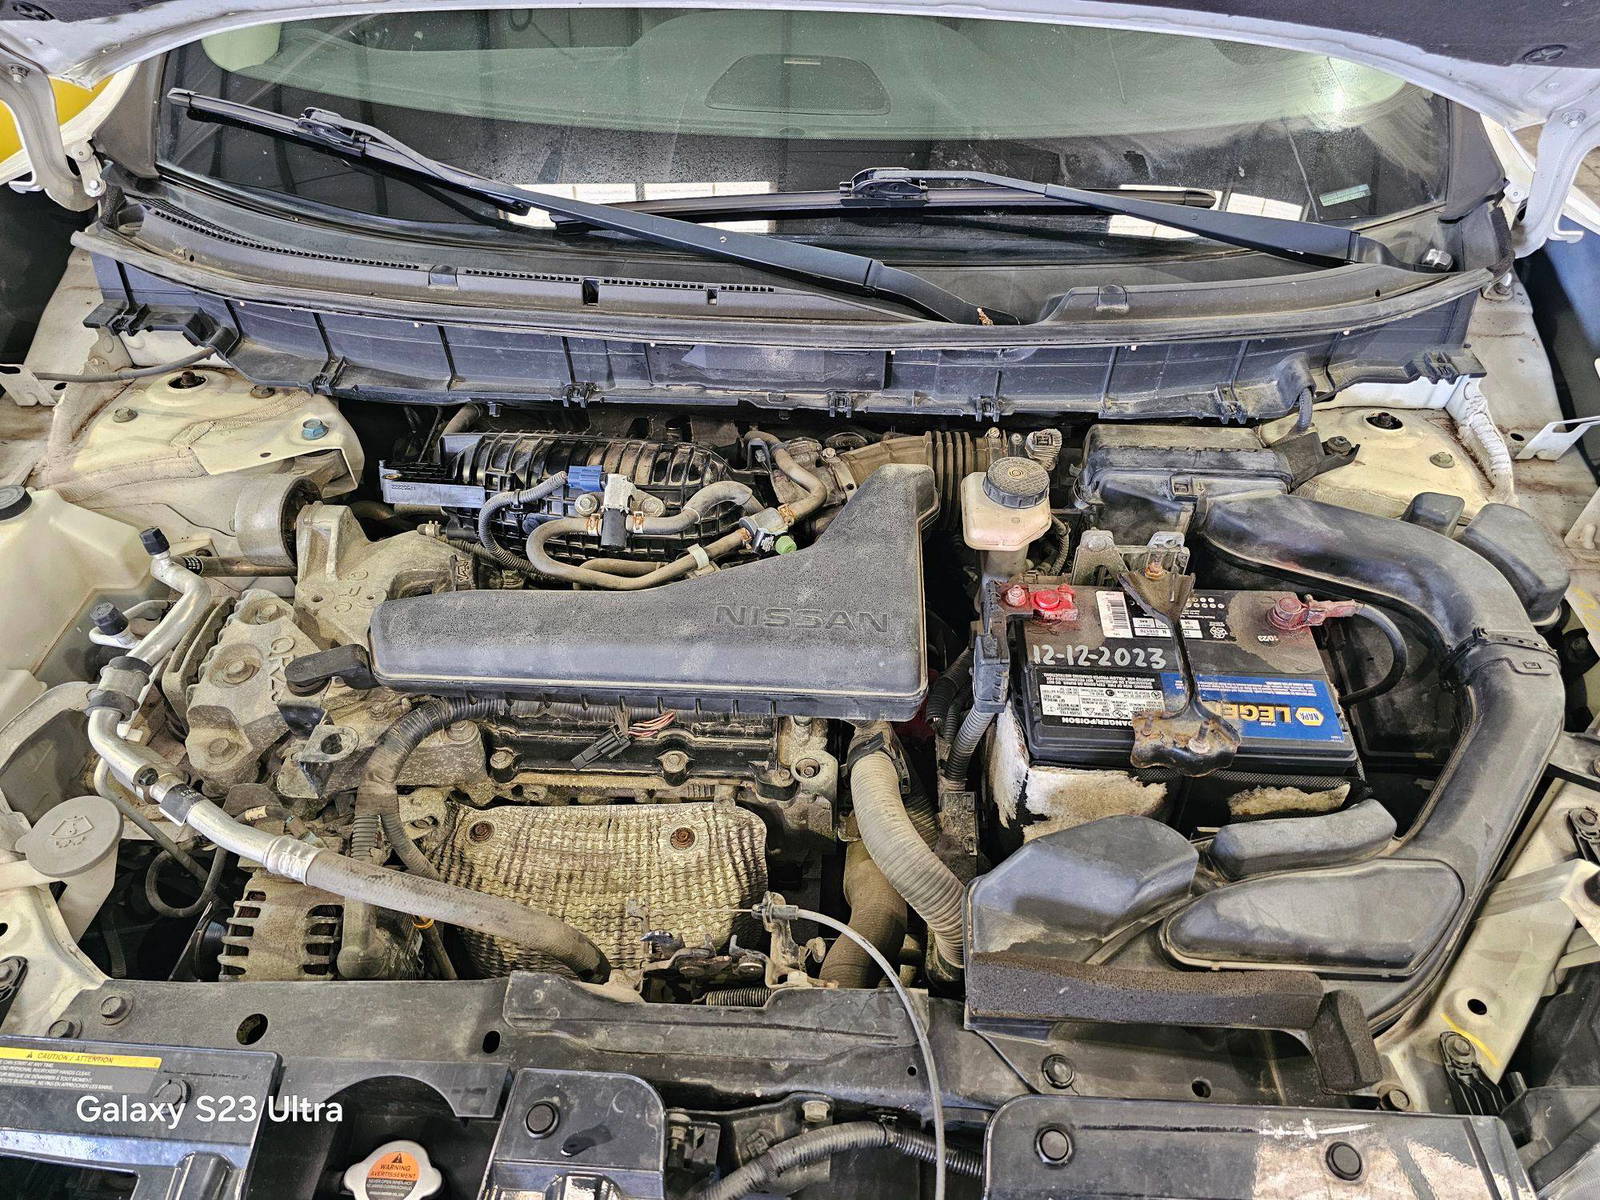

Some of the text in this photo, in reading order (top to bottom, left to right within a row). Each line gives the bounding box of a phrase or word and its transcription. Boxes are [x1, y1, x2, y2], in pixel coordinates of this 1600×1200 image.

[715, 605, 888, 632] NISSAN
[1033, 644, 1167, 669] 12-12-2023
[1216, 703, 1292, 723] LEGE
[1300, 711, 1319, 721] NAPA
[37, 1052, 68, 1060] CAUTION
[76, 1055, 114, 1064] ATTENTION
[371, 1171, 416, 1179] AVERTISSEMENT
